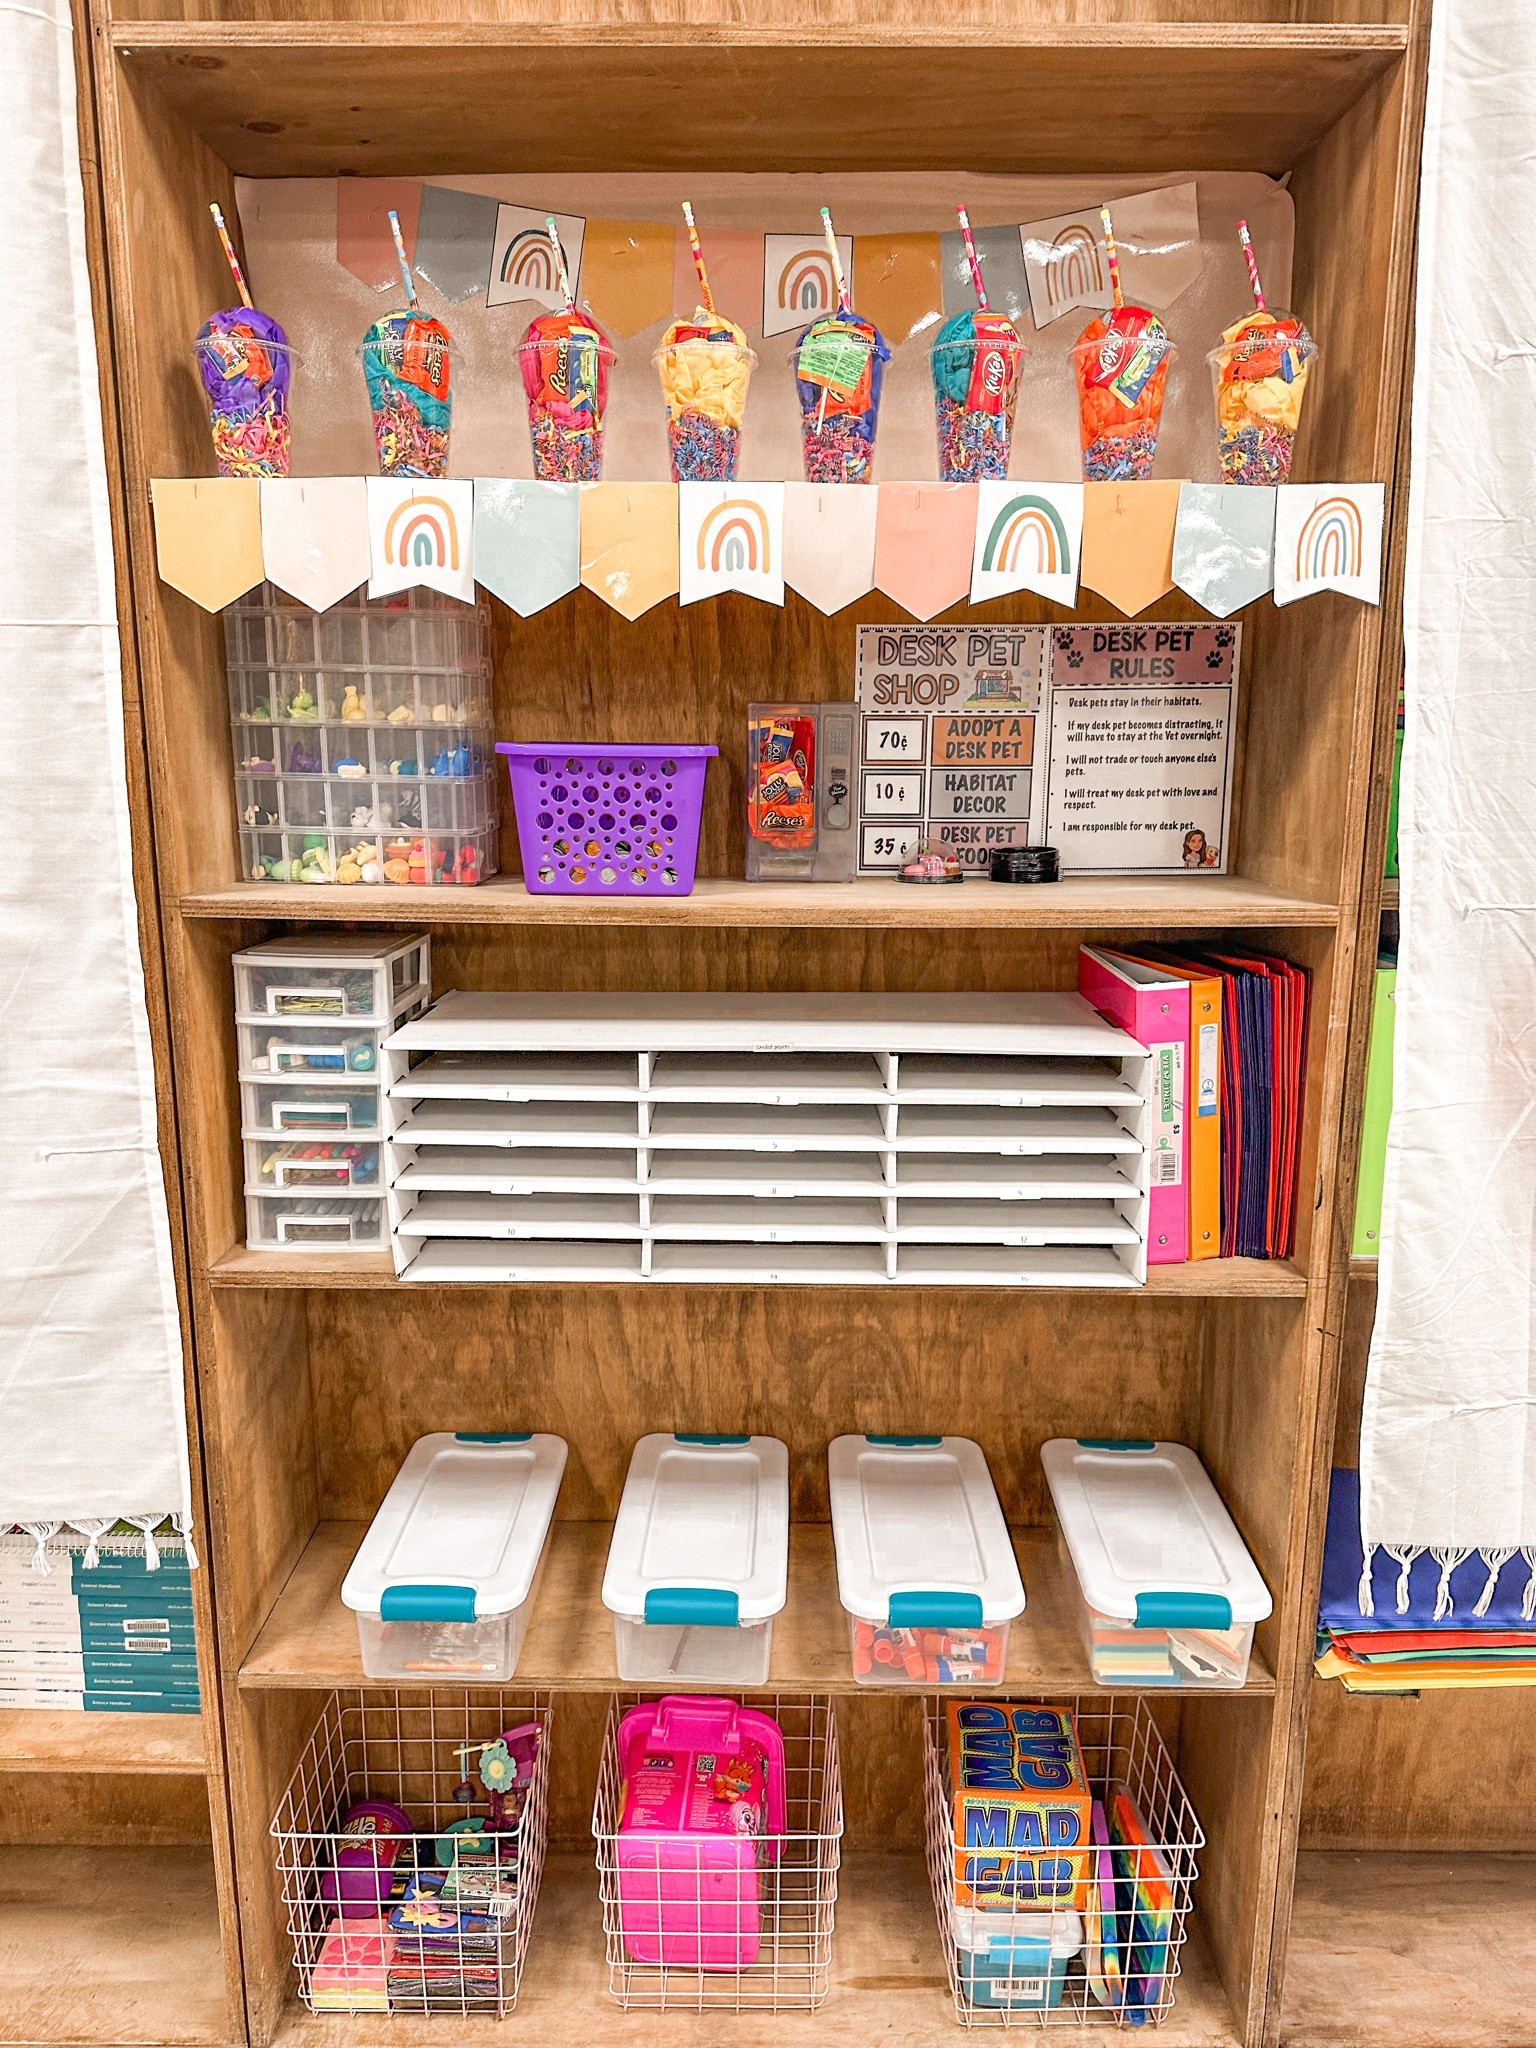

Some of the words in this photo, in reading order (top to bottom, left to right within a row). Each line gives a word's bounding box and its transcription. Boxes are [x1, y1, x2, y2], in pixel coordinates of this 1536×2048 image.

[548, 334, 569, 396] Reese's
[1093, 631, 1148, 652] DESK
[1155, 631, 1194, 651] PET
[878, 635, 957, 666] DESK
[967, 635, 1026, 666] PET
[1109, 657, 1175, 679] RULES
[873, 673, 960, 705] SHOP
[1069, 698, 1088, 707] Desk
[1090, 698, 1108, 709] pets
[1110, 698, 1129, 709] stay
[1130, 697, 1139, 706] in
[1140, 697, 1161, 707] their
[1163, 697, 1202, 706] habitats.
[947, 719, 1005, 737] ADOPT
[1009, 719, 1022, 737] A
[1067, 721, 1077, 731] If
[1077, 722, 1090, 732] my
[1091, 720, 1110, 730] desk
[1112, 721, 1126, 732] pet
[1128, 720, 1163, 730] becomes
[1164, 719, 1214, 731] distracting,
[1215, 719, 1223, 729] it
[1067, 732, 1083, 742] will
[1085, 732, 1105, 742] have
[1106, 732, 1115, 741] to
[1117, 732, 1136, 743] stay
[1138, 732, 1147, 741] at
[1149, 731, 1164, 740] the
[1165, 731, 1180, 740] Vet
[1181, 730, 1223, 742] overnight.
[945, 742, 987, 760] DESK
[992, 742, 1022, 759] PET
[1066, 755, 1069, 764] I
[1071, 755, 1087, 764] will
[1088, 755, 1103, 764] not
[1105, 755, 1128, 764] trade
[1140, 754, 1163, 763] touch
[1165, 755, 1195, 765] anyone
[1197, 753, 1217, 763] else's
[1065, 767, 1085, 778] pets.
[762, 778, 783, 798] JOLLY
[876, 783, 894, 799] 10
[945, 774, 1017, 791] HABITAT
[1064, 789, 1068, 798] I
[1069, 788, 1085, 798] will
[1087, 788, 1109, 798] treat
[1111, 790, 1124, 799] my
[1126, 788, 1145, 798] desk
[1146, 788, 1160, 799] pet
[1162, 787, 1182, 797] with
[1184, 787, 1201, 797] love
[1202, 787, 1218, 796] and
[953, 796, 1006, 813] DECOR
[1064, 800, 1096, 811] respect.
[762, 811, 805, 827] Reese's
[1062, 822, 1066, 831] I
[1082, 821, 1128, 833] responsible
[1129, 821, 1143, 831] for
[1144, 822, 1158, 832] my
[1159, 821, 1178, 830] desk
[1179, 821, 1195, 831] pet.
[940, 826, 981, 844] DESK
[985, 826, 1016, 843] PET
[874, 838, 896, 855] 35
[1162, 1055, 1171, 1080] VIEW
[1173, 1124, 1180, 1134] $3
[958, 1705, 1023, 1791] MAD
[1012, 1709, 1072, 1790] GAB
[965, 1806, 1080, 1854] MAD
[965, 1857, 1072, 1899] GAB
